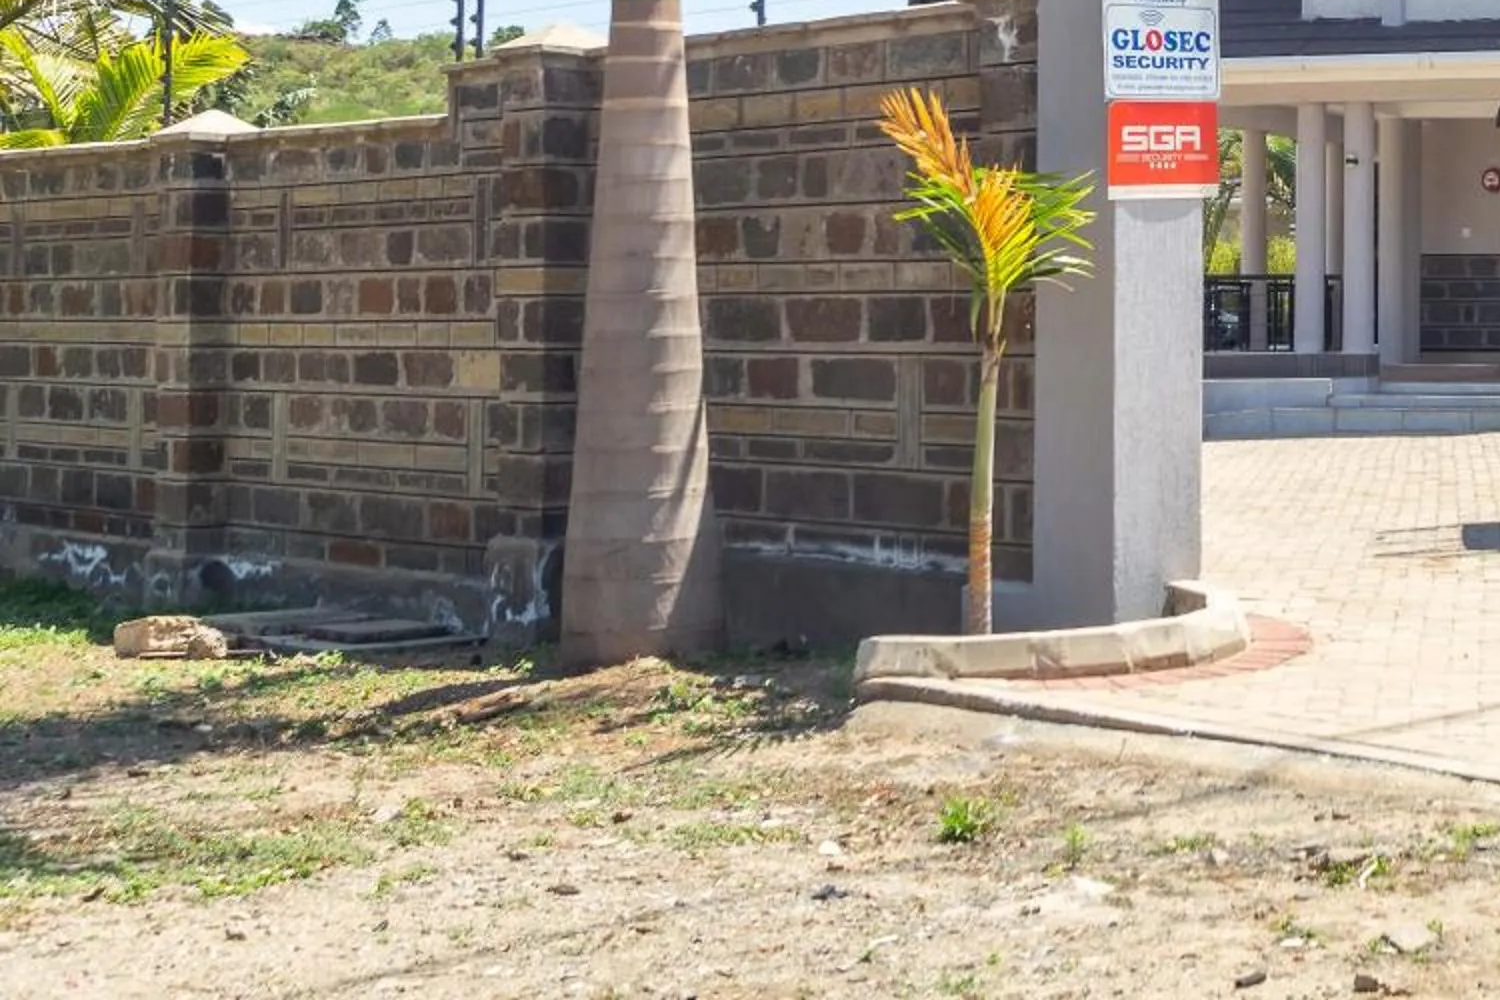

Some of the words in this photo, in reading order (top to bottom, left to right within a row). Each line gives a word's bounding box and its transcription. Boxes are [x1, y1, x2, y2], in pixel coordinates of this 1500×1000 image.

[1111, 28, 1211, 53] GLOSEC
[1112, 55, 1210, 70] SECURITY
[1121, 125, 1201, 151] SGA
